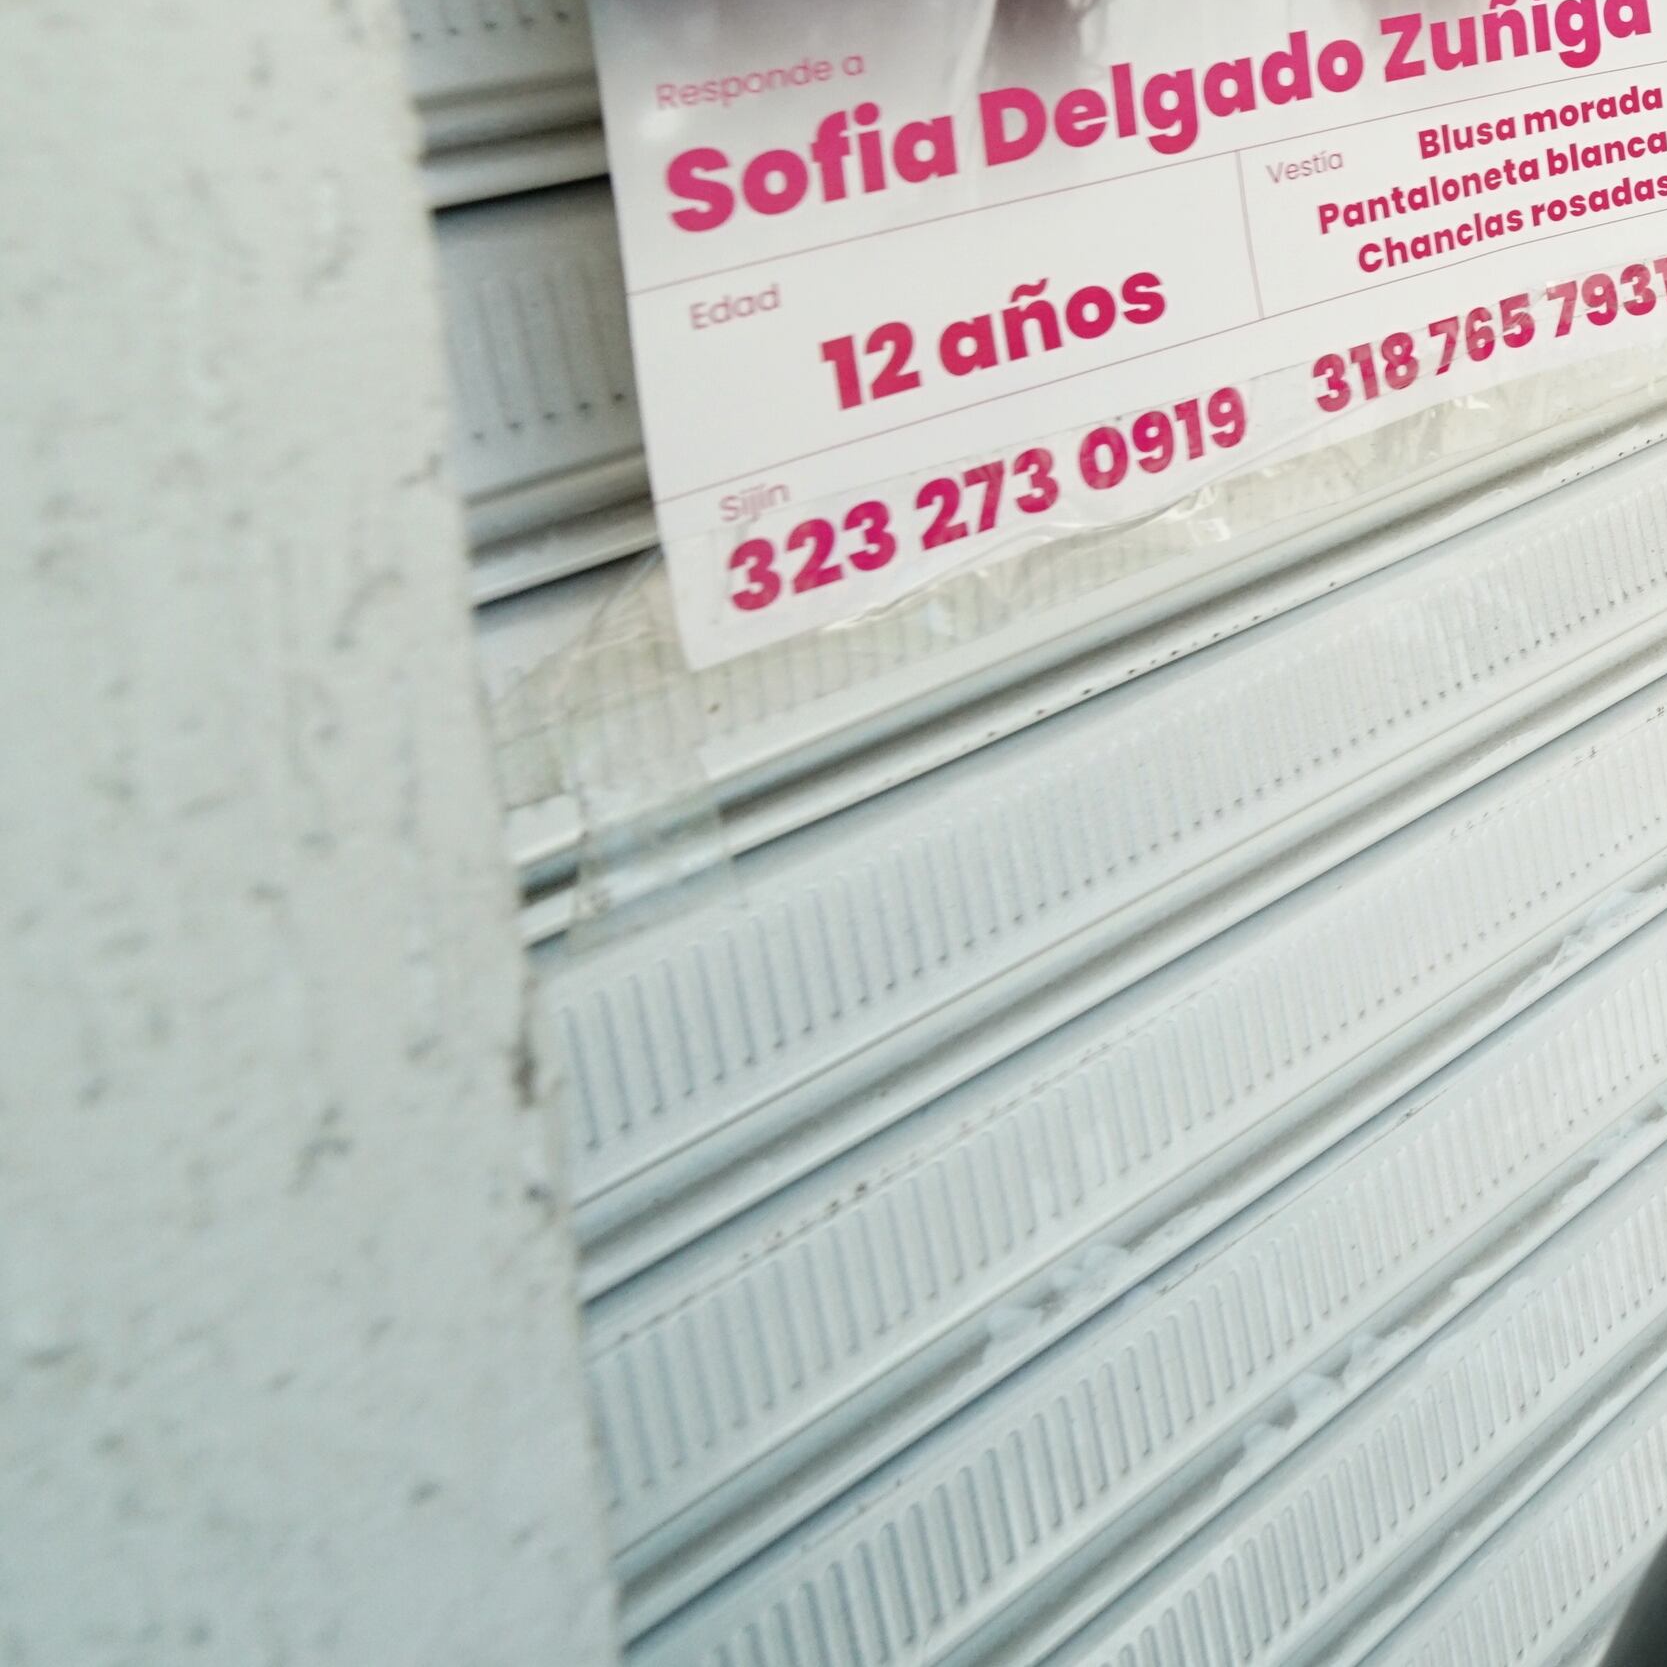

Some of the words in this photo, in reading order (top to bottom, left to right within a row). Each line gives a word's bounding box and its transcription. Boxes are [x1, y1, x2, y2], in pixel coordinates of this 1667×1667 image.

[655, 56, 834, 109] Responde
[841, 54, 865, 78] a
[665, 101, 958, 234] Sofia
[977, 29, 1366, 156] Delgado
[1416, 116, 1518, 160] Blusa
[1522, 84, 1665, 136] morada
[1265, 149, 1344, 183] Vestía
[1316, 157, 1542, 236] Pantaloneta
[1357, 208, 1525, 274] Chanclas
[690, 283, 780, 329] Edad
[820, 320, 922, 410] 12
[937, 270, 1167, 378] años
[1311, 330, 1419, 413] 318
[1427, 293, 1537, 376] 765
[728, 499, 898, 612] 323
[914, 447, 1061, 551] 273
[1077, 386, 1247, 490] 0919
